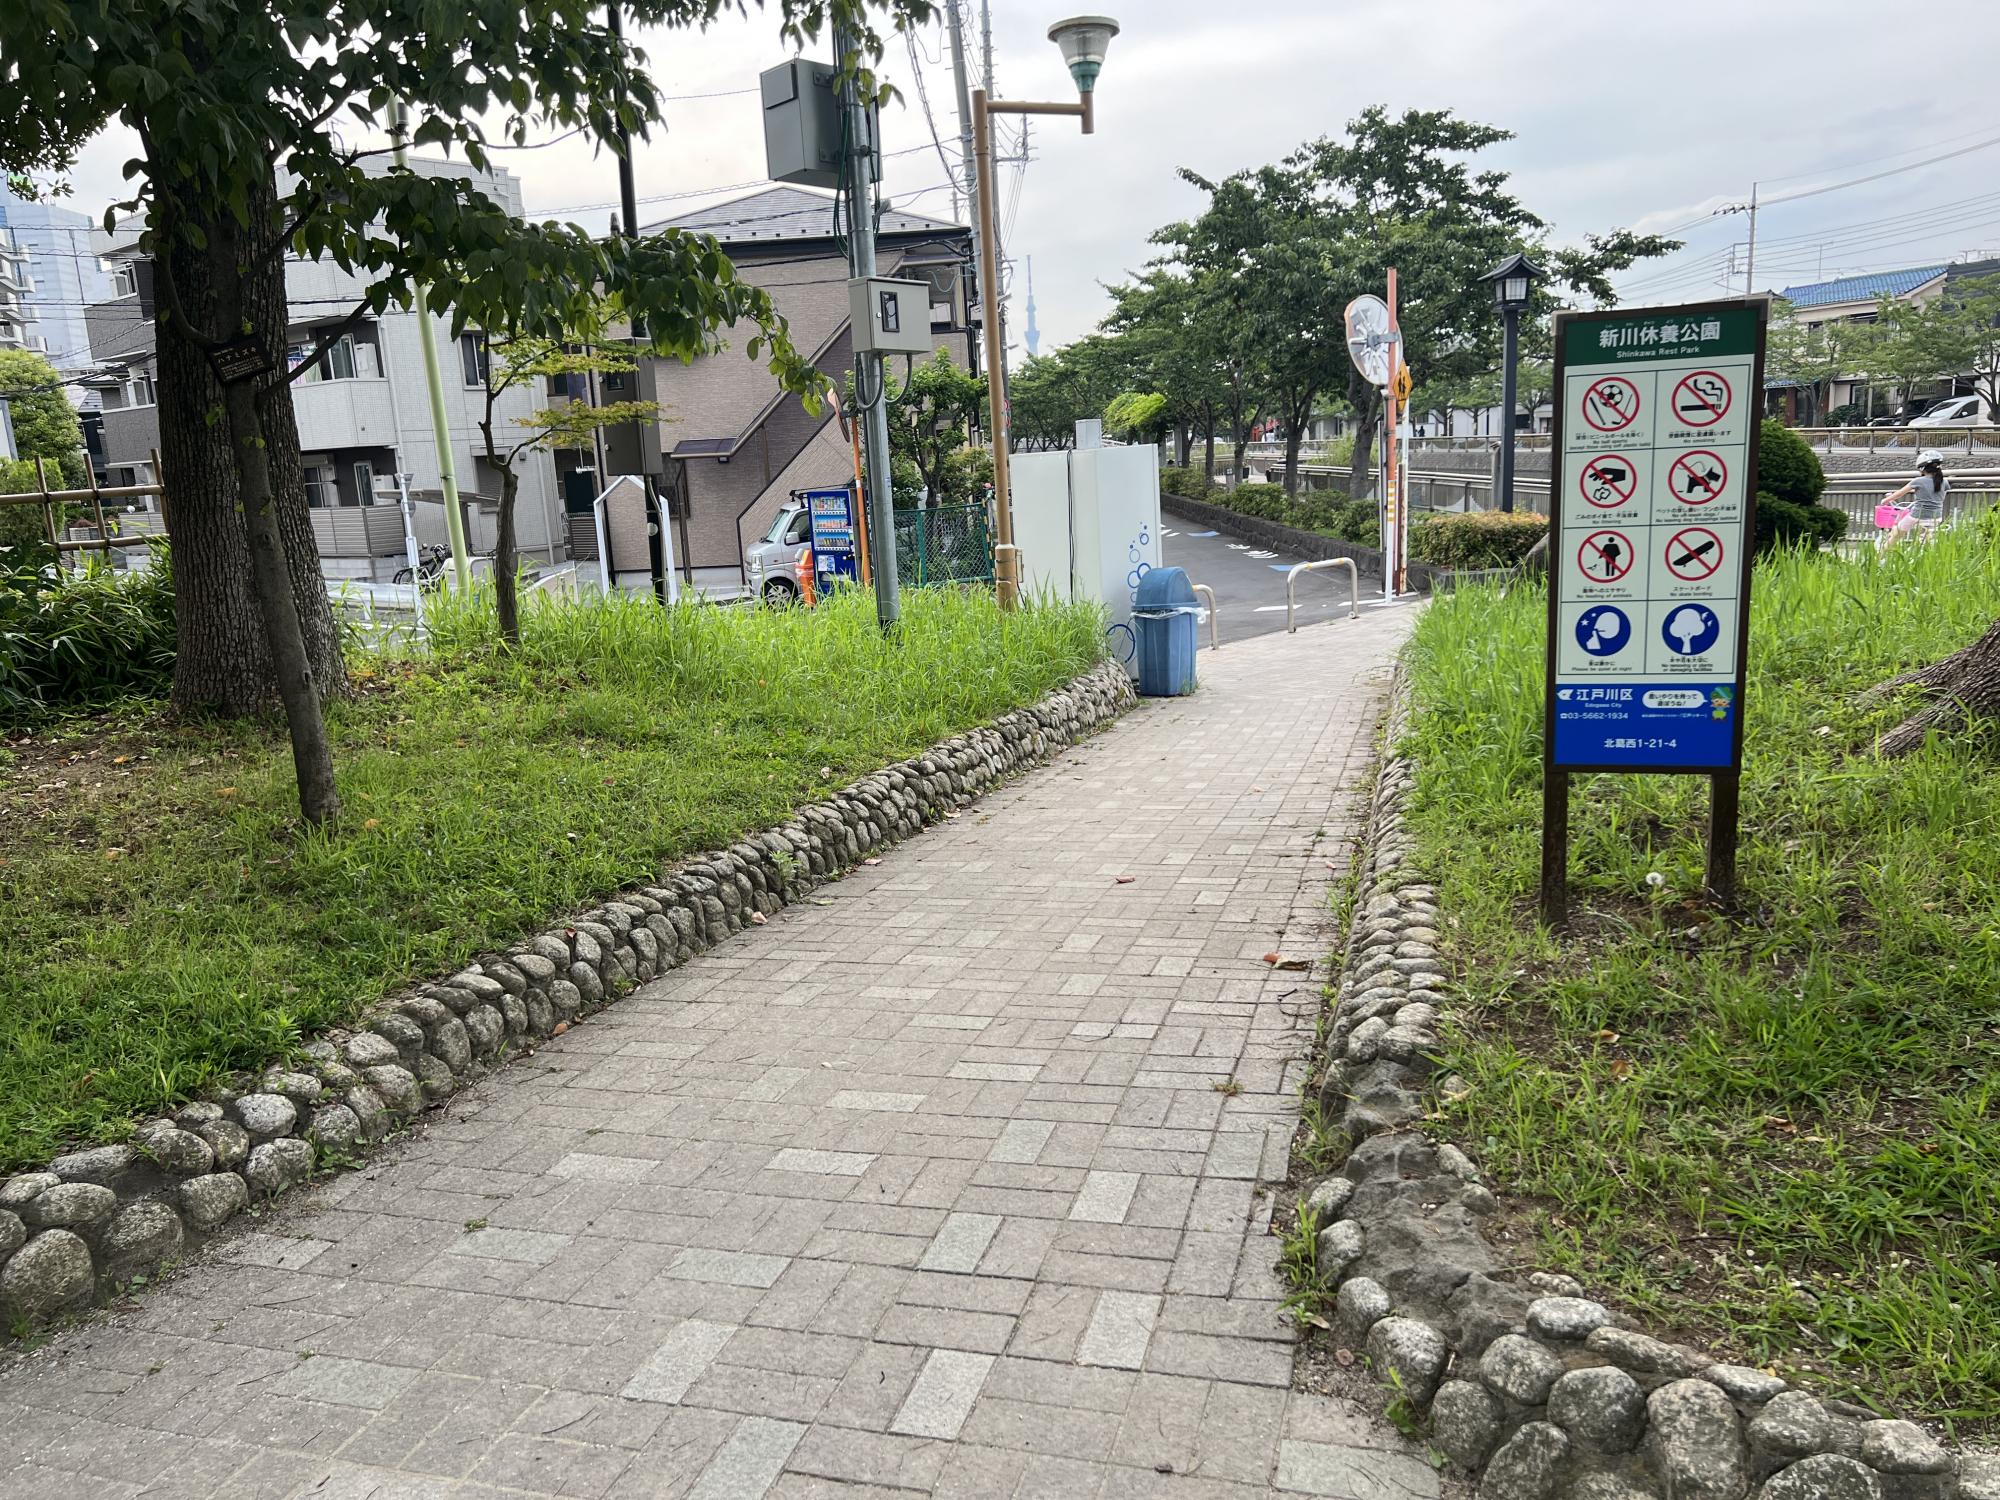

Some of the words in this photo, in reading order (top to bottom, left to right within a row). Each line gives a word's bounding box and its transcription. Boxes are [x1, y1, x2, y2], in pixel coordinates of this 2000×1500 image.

[1599, 321, 1721, 348] 新川休養公園
[1616, 350, 1656, 358] Shinkawa
[1576, 688, 1633, 700] 江戸川区
[1604, 738, 1677, 748] 北葛西1-21-4
